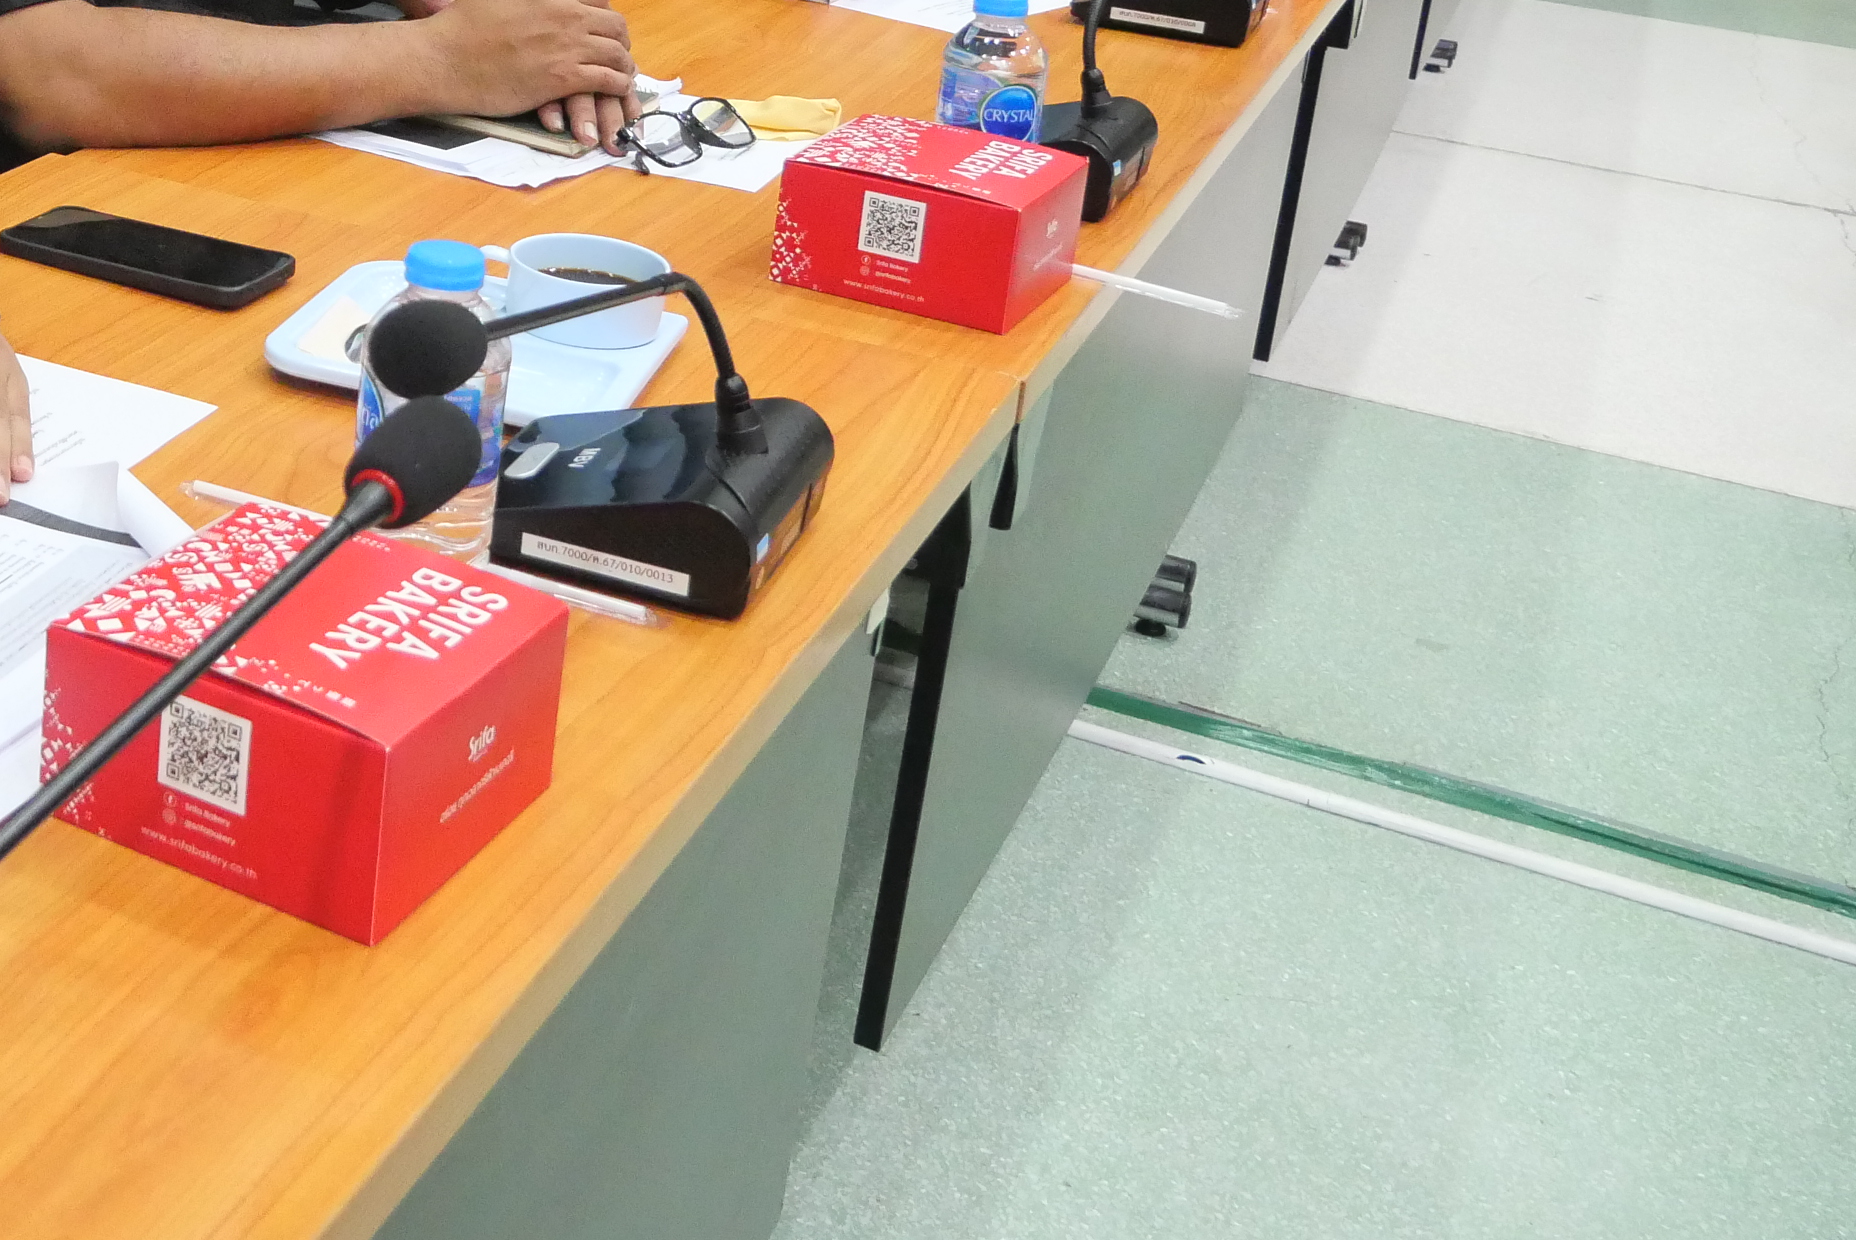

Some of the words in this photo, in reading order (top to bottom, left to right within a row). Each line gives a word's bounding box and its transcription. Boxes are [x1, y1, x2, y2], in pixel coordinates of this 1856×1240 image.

[983, 107, 1034, 123] CRYSTAL
[948, 140, 1022, 180] BAKERY
[992, 148, 1053, 179] SRIFA
[308, 567, 464, 670] BAKERY
[386, 585, 509, 660] SRIFA
